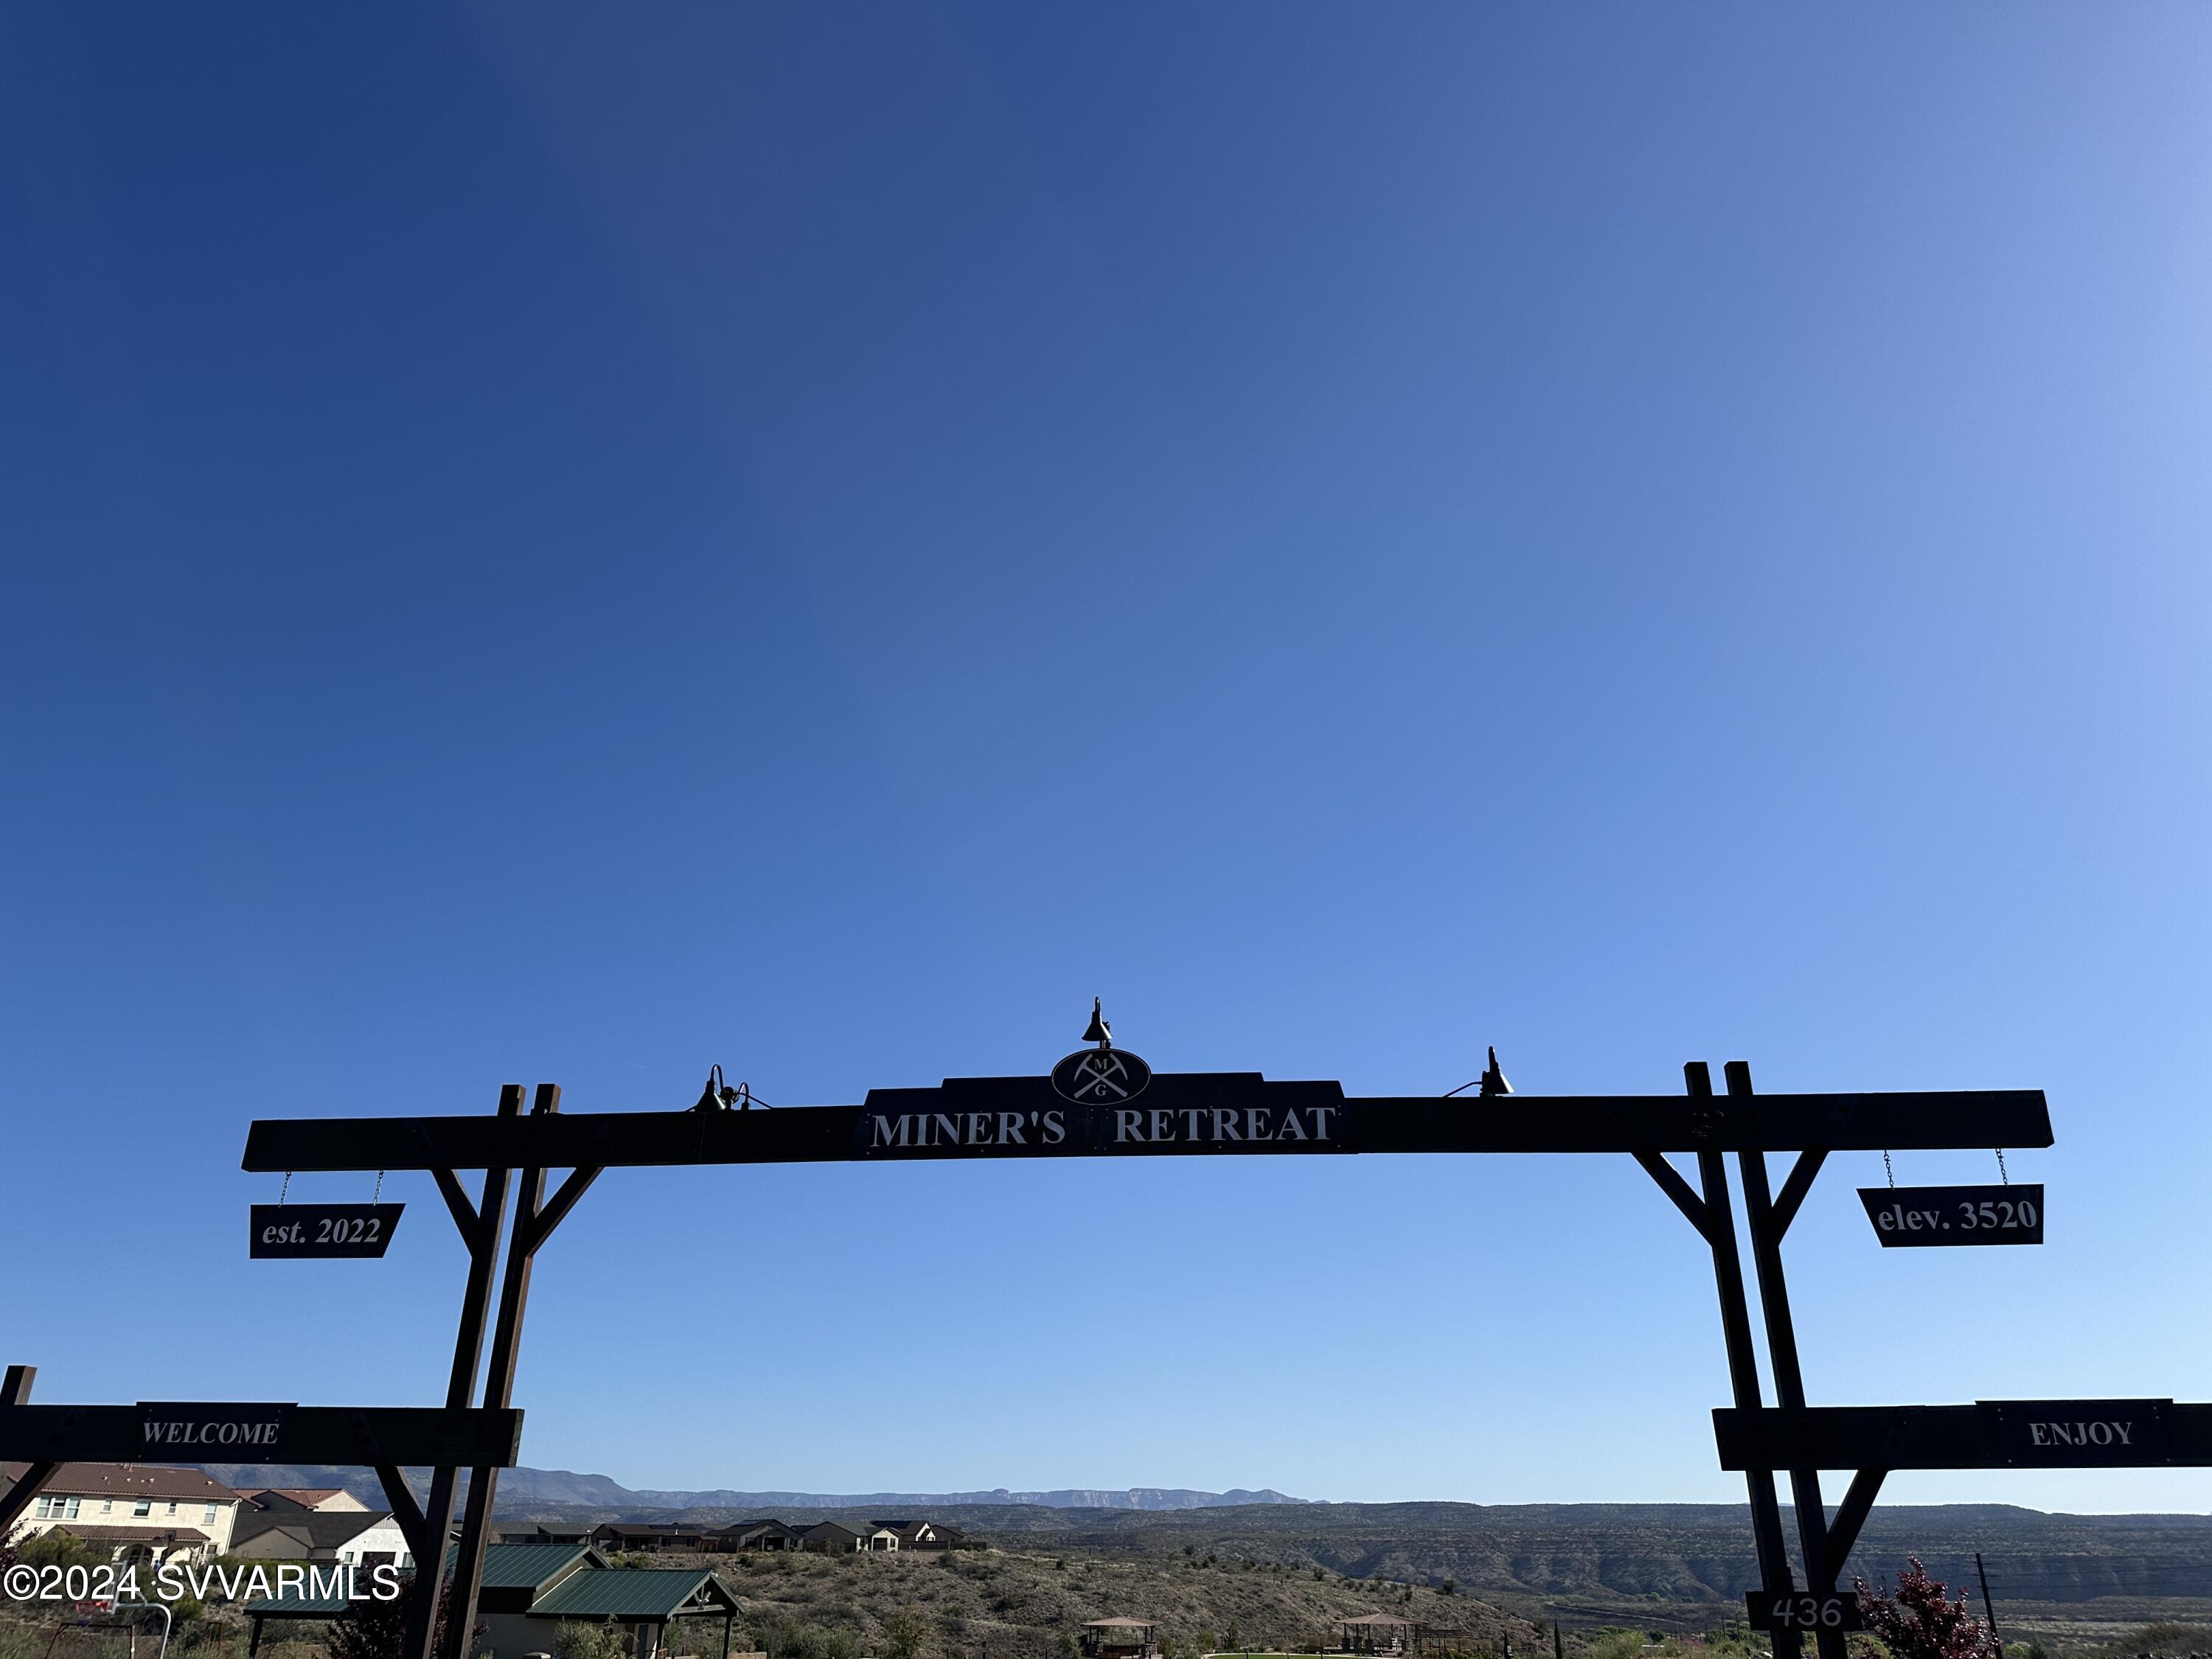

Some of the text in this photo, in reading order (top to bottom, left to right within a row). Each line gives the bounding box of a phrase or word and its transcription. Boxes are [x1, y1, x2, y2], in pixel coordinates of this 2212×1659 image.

[1094, 1058, 1108, 1070] M
[1094, 1084, 1107, 1096] G
[870, 1107, 1336, 1147] MINER'S RETREAT
[1878, 1200, 2037, 1231] elev. 3520
[262, 1218, 380, 1244] est. 2022
[144, 1422, 279, 1444] WELCOME
[2028, 1422, 2133, 1445] ENJOY
[1772, 1598, 1842, 1627] 436
